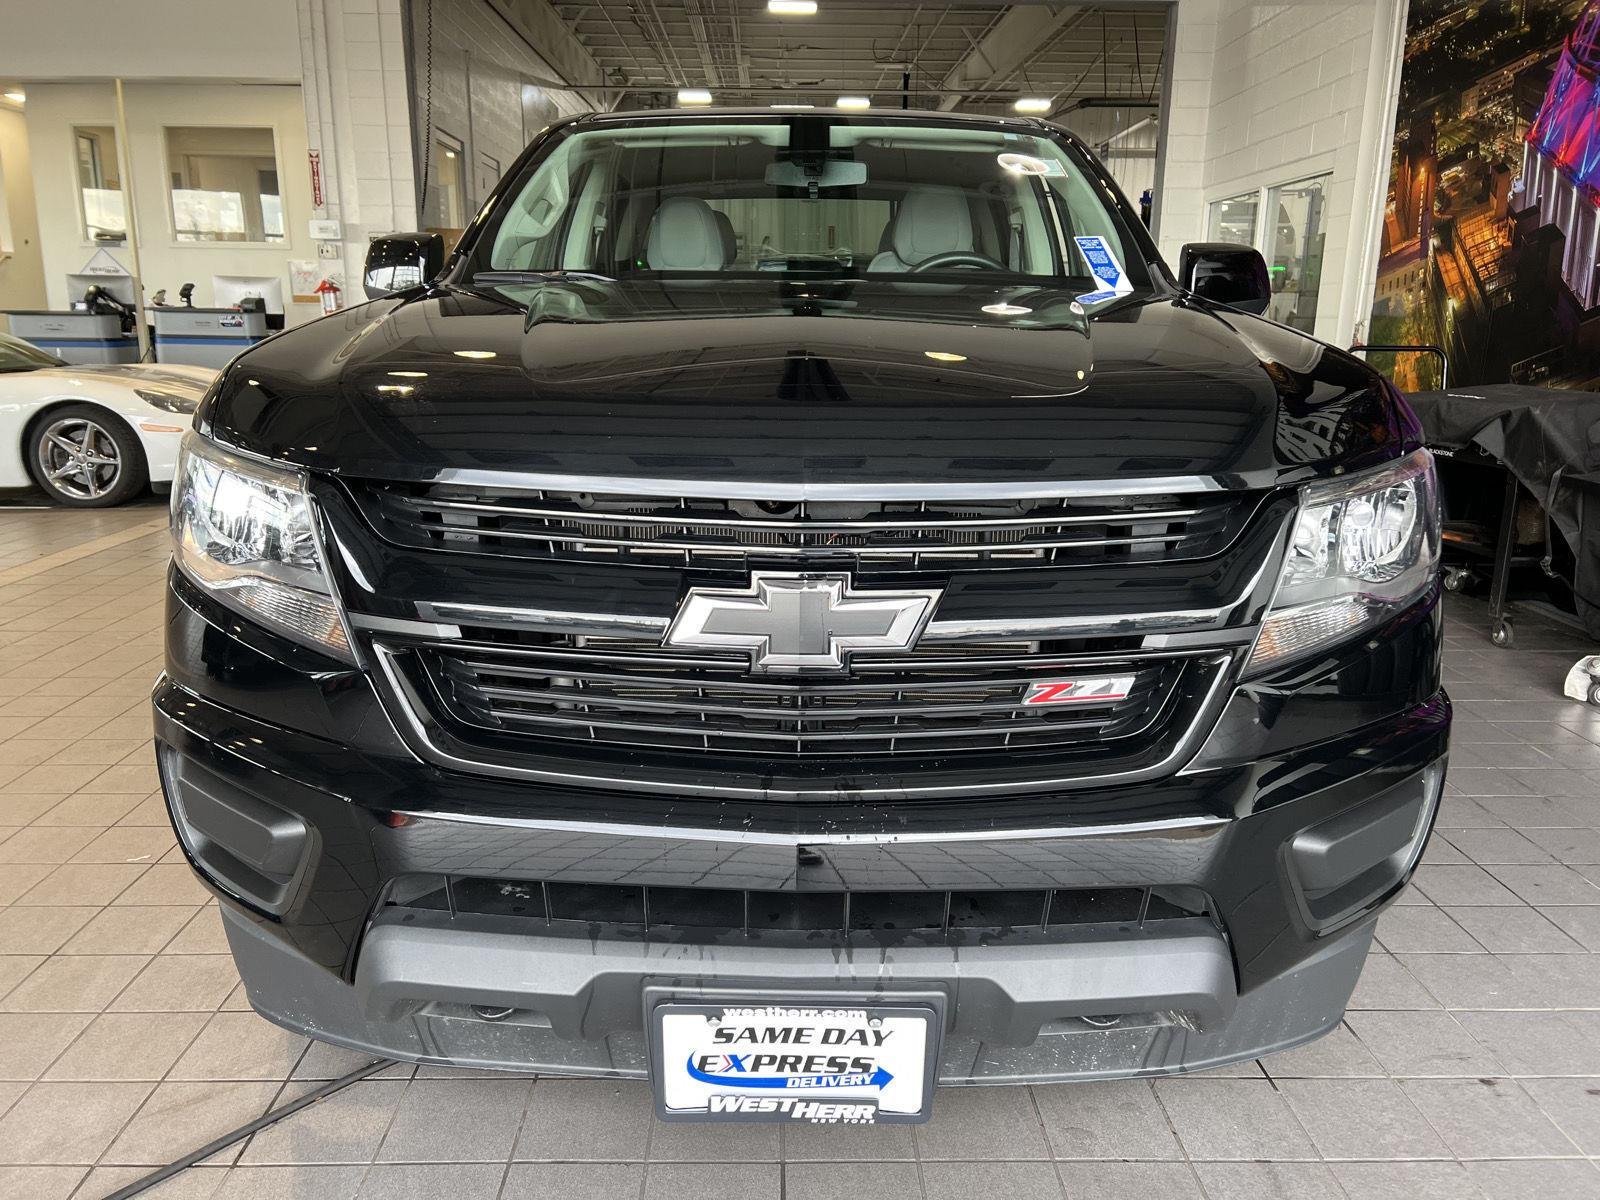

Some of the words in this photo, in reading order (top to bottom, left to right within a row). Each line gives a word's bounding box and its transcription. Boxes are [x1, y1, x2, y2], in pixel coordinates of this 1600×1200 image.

[1023, 677, 1136, 704] Z71
[723, 1007, 867, 1018] westherr.com
[713, 1027, 815, 1044] SAME
[821, 1028, 895, 1046] DAY
[697, 1054, 875, 1074] EXPRESS
[786, 1073, 876, 1088] DELIVERY
